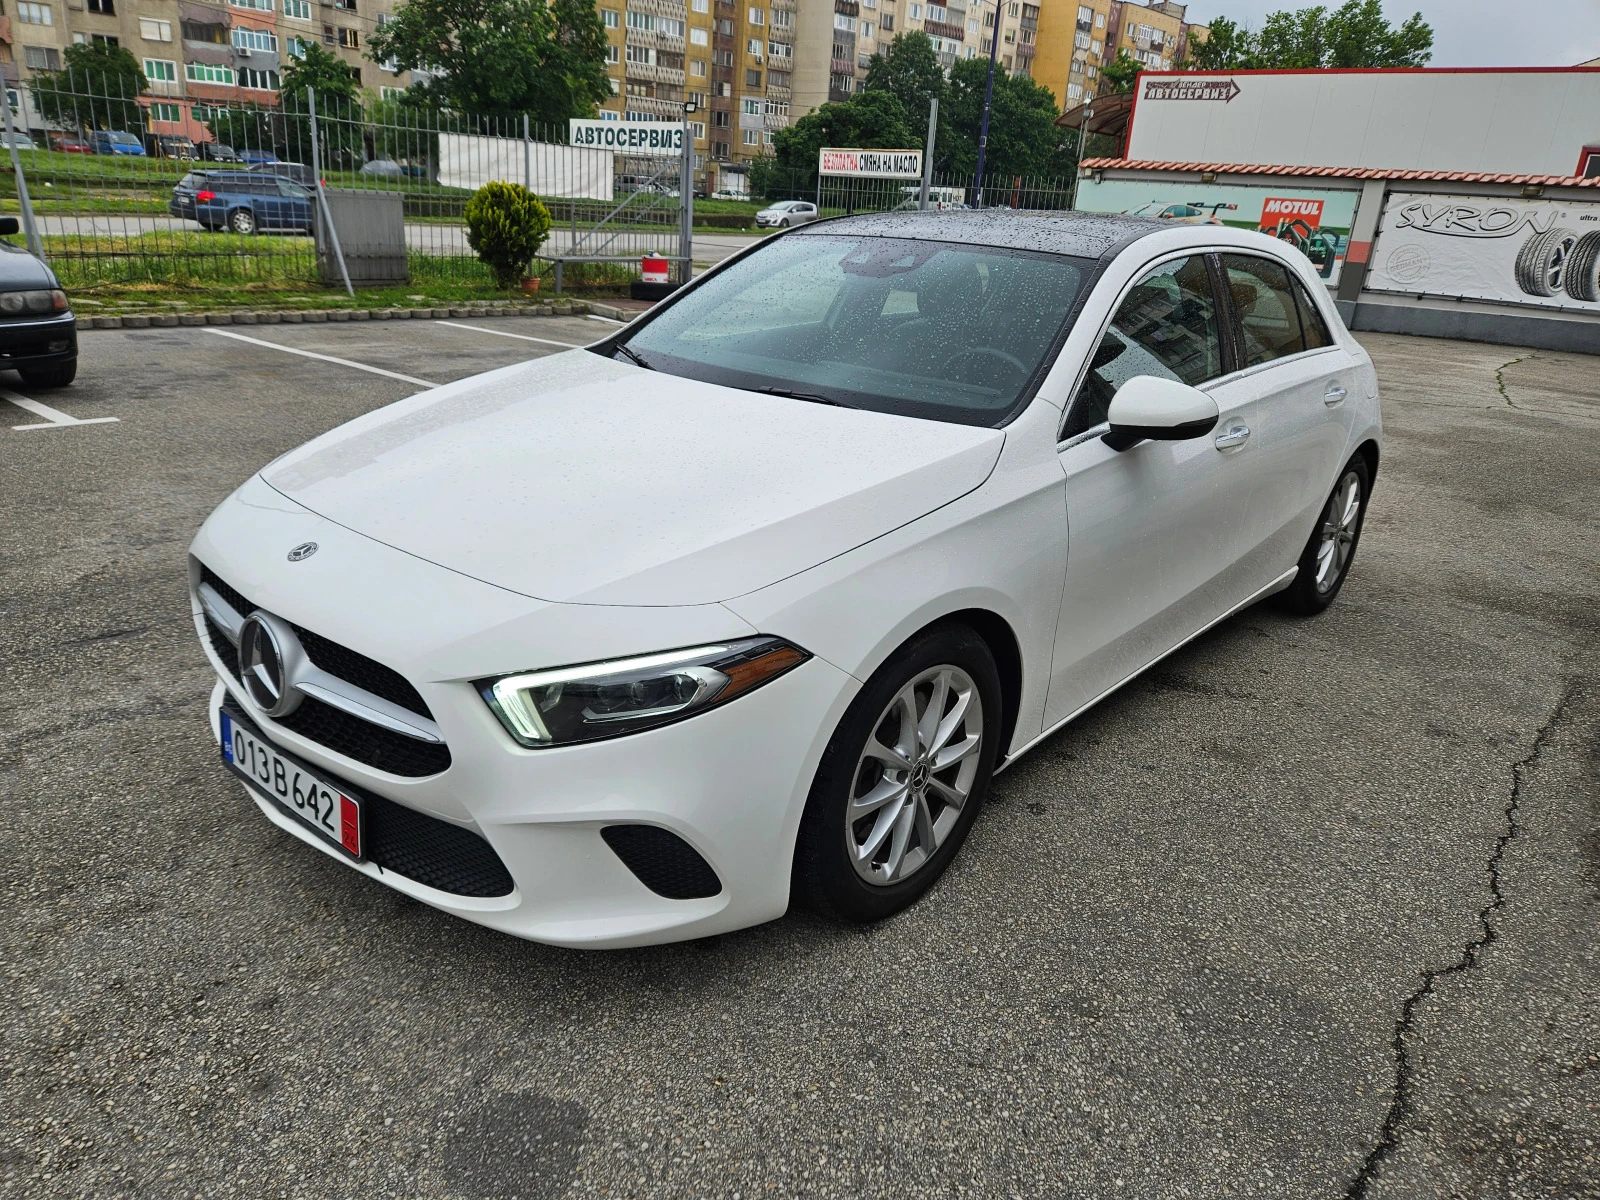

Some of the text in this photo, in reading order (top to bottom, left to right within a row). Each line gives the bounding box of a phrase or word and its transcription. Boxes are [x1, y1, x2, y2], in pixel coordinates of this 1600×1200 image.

[1147, 87, 1228, 99] АВТОСЕРВИЗ
[574, 126, 683, 149] АВТОСЕРВИЗ
[823, 153, 918, 173] БЕЗПЛАТНА СМЯНА НА МАСЛО
[1265, 200, 1320, 215] MOTUL
[1395, 203, 1559, 238] SYRON
[1580, 214, 1598, 222] ultra
